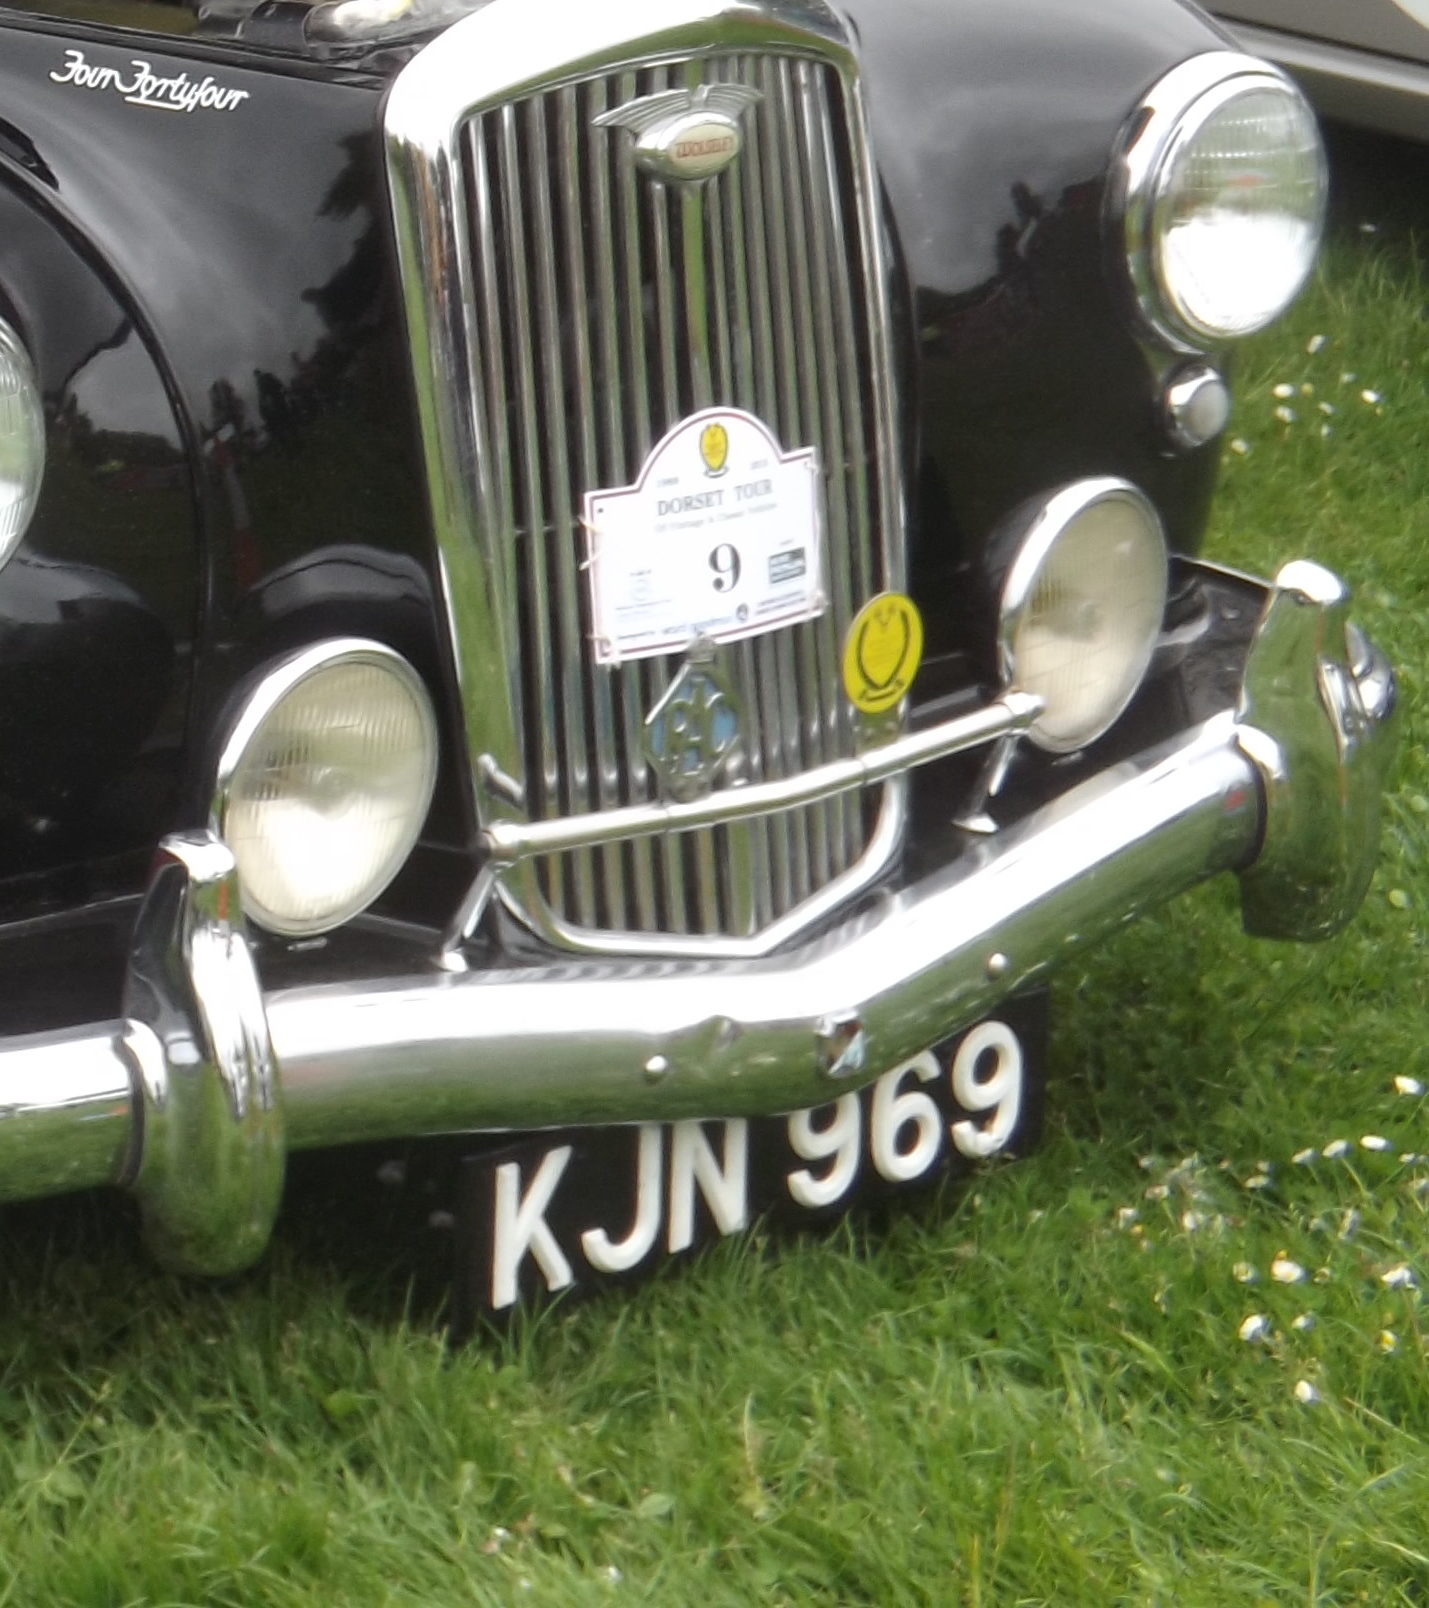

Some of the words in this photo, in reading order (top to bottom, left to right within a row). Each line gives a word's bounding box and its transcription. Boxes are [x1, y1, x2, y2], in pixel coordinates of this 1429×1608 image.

[657, 489, 724, 517] DORSET
[736, 479, 774, 502] TOUR
[708, 543, 742, 593] 9
[491, 1120, 750, 1310] KJN
[785, 1020, 1023, 1209] 969
